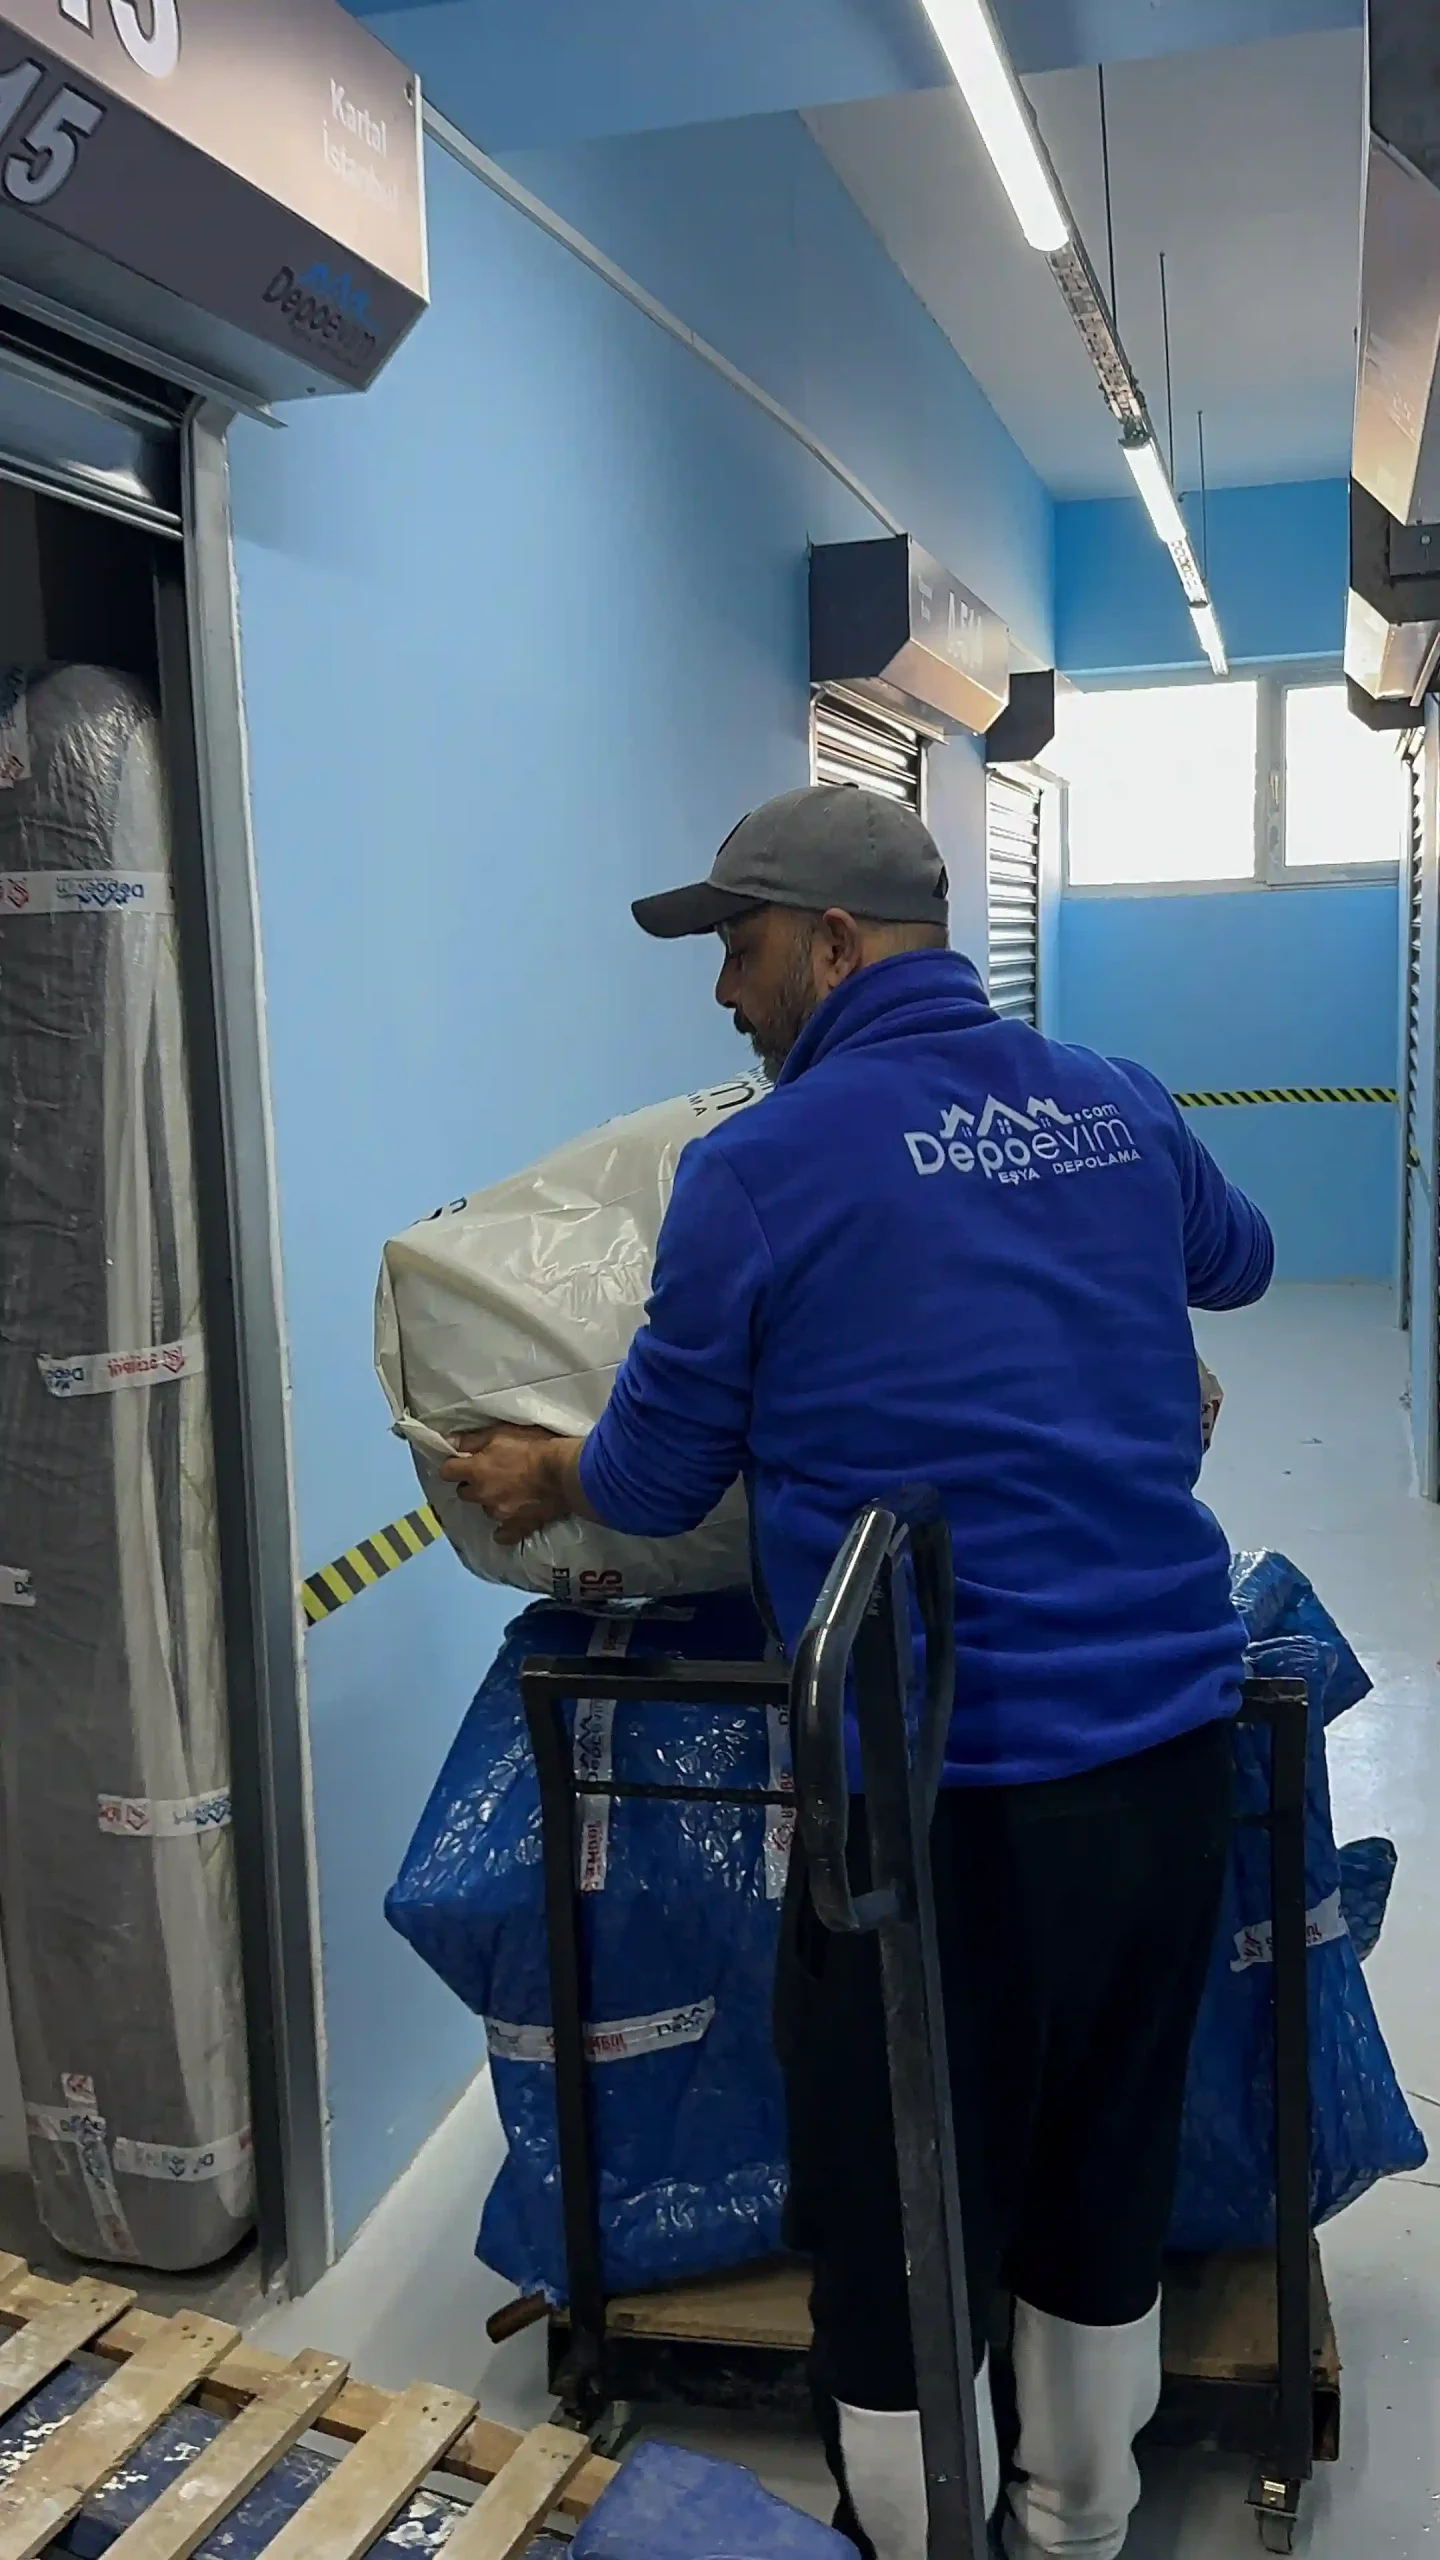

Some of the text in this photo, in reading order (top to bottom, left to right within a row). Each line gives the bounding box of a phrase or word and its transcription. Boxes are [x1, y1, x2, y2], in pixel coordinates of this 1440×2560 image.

[329, 77, 387, 159] Kartal
[904, 1118, 1136, 1179] Depoevim
[1052, 1148, 1143, 1176] DEPOLAMA
